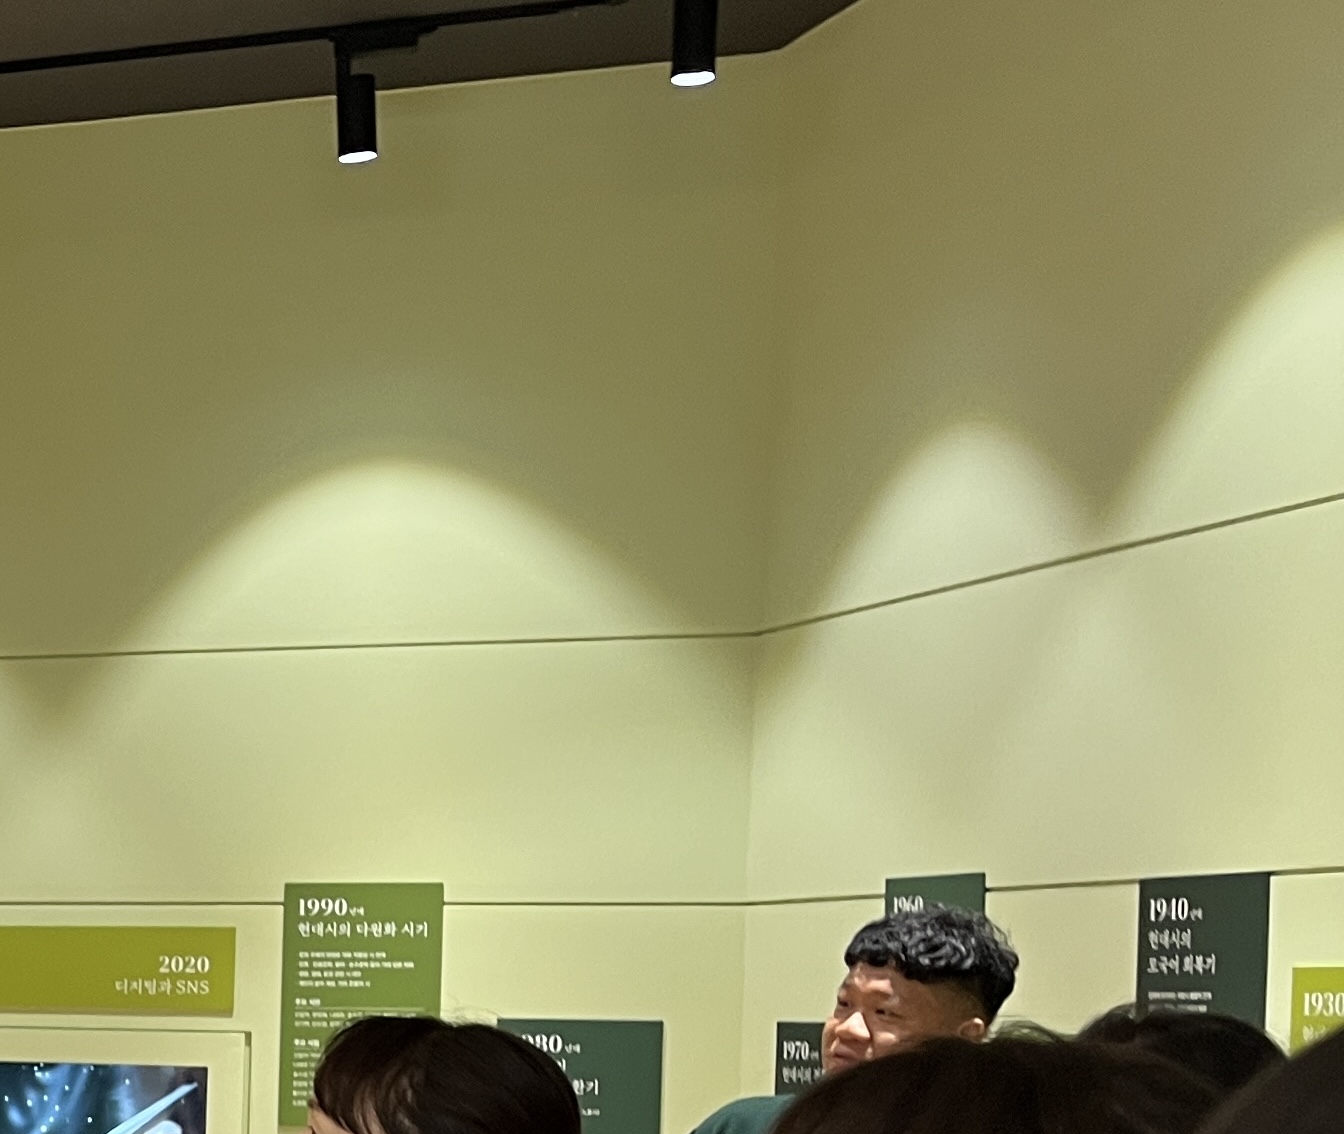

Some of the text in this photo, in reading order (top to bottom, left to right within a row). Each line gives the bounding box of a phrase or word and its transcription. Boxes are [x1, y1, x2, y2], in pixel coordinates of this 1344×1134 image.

[297, 921, 428, 938] 현대시의 다원화 시기
[158, 955, 210, 974] 2020
[175, 979, 210, 995] SNS
